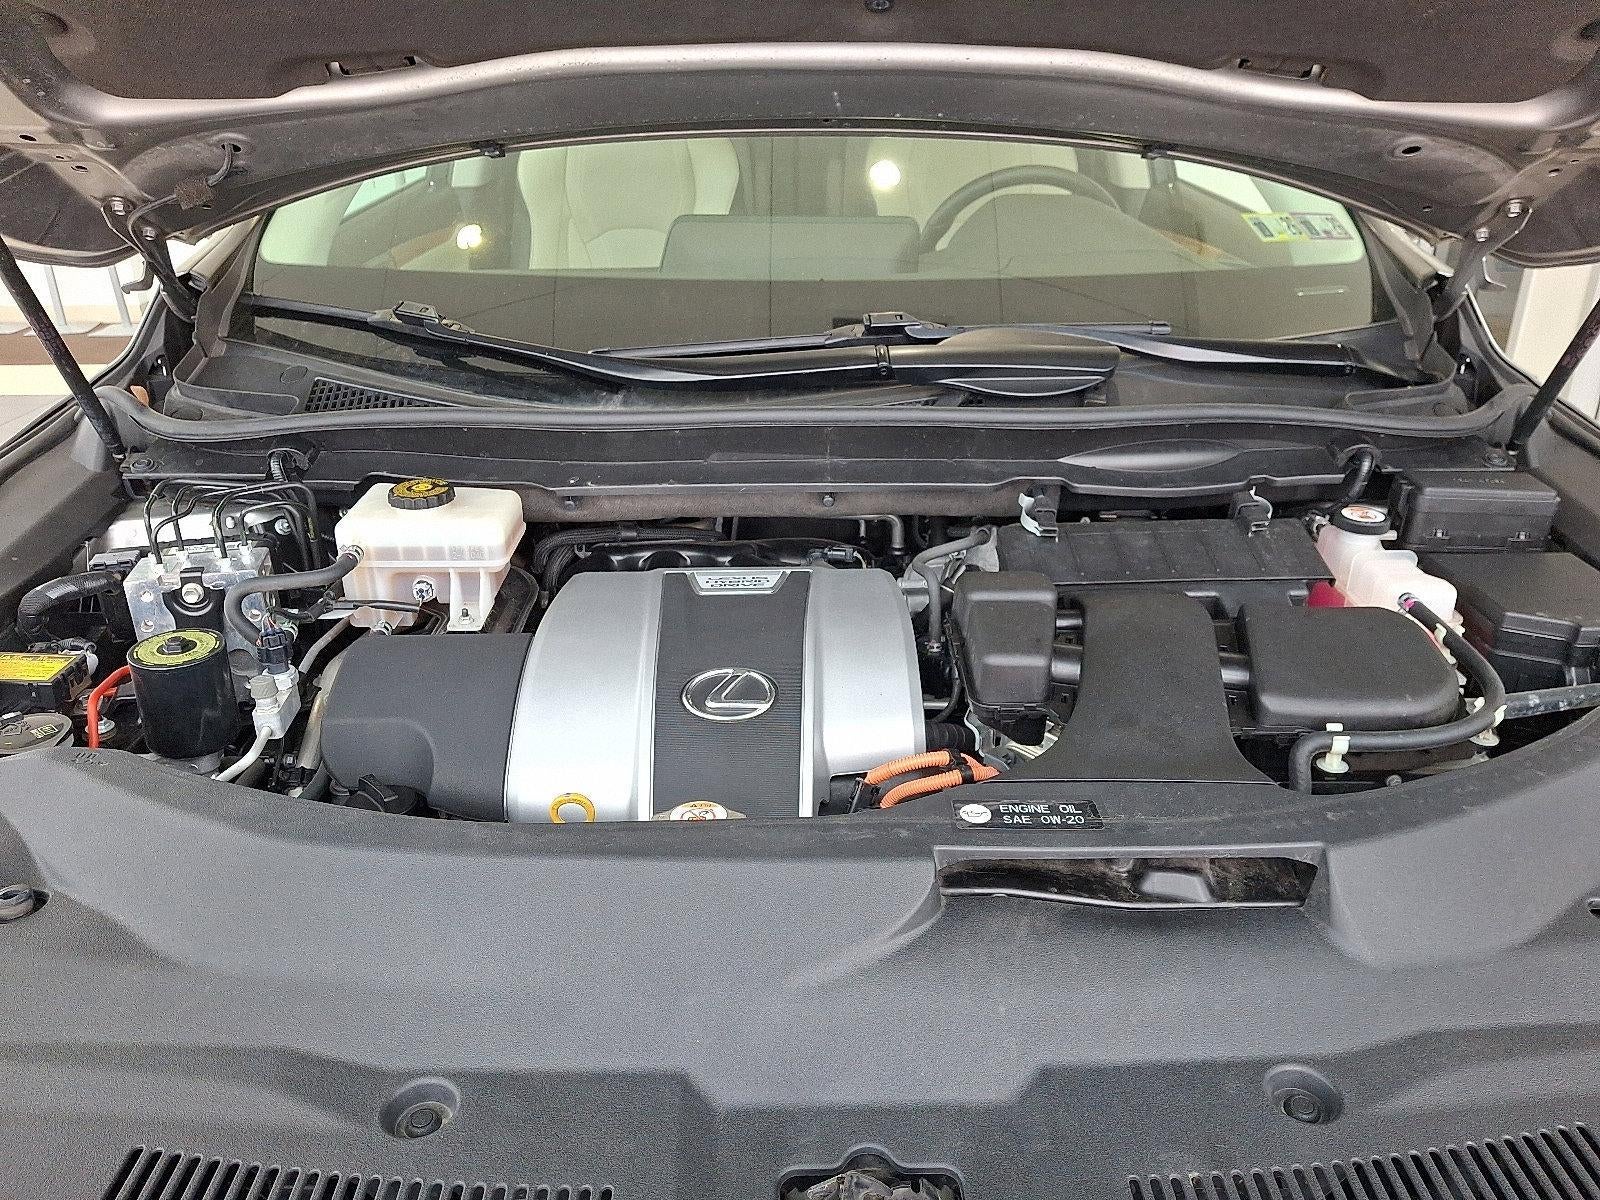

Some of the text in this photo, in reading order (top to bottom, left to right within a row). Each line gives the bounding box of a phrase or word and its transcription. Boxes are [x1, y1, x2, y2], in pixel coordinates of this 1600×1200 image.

[1000, 804, 1082, 813] ENGINE OIL
[1003, 815, 1032, 824] SAE
